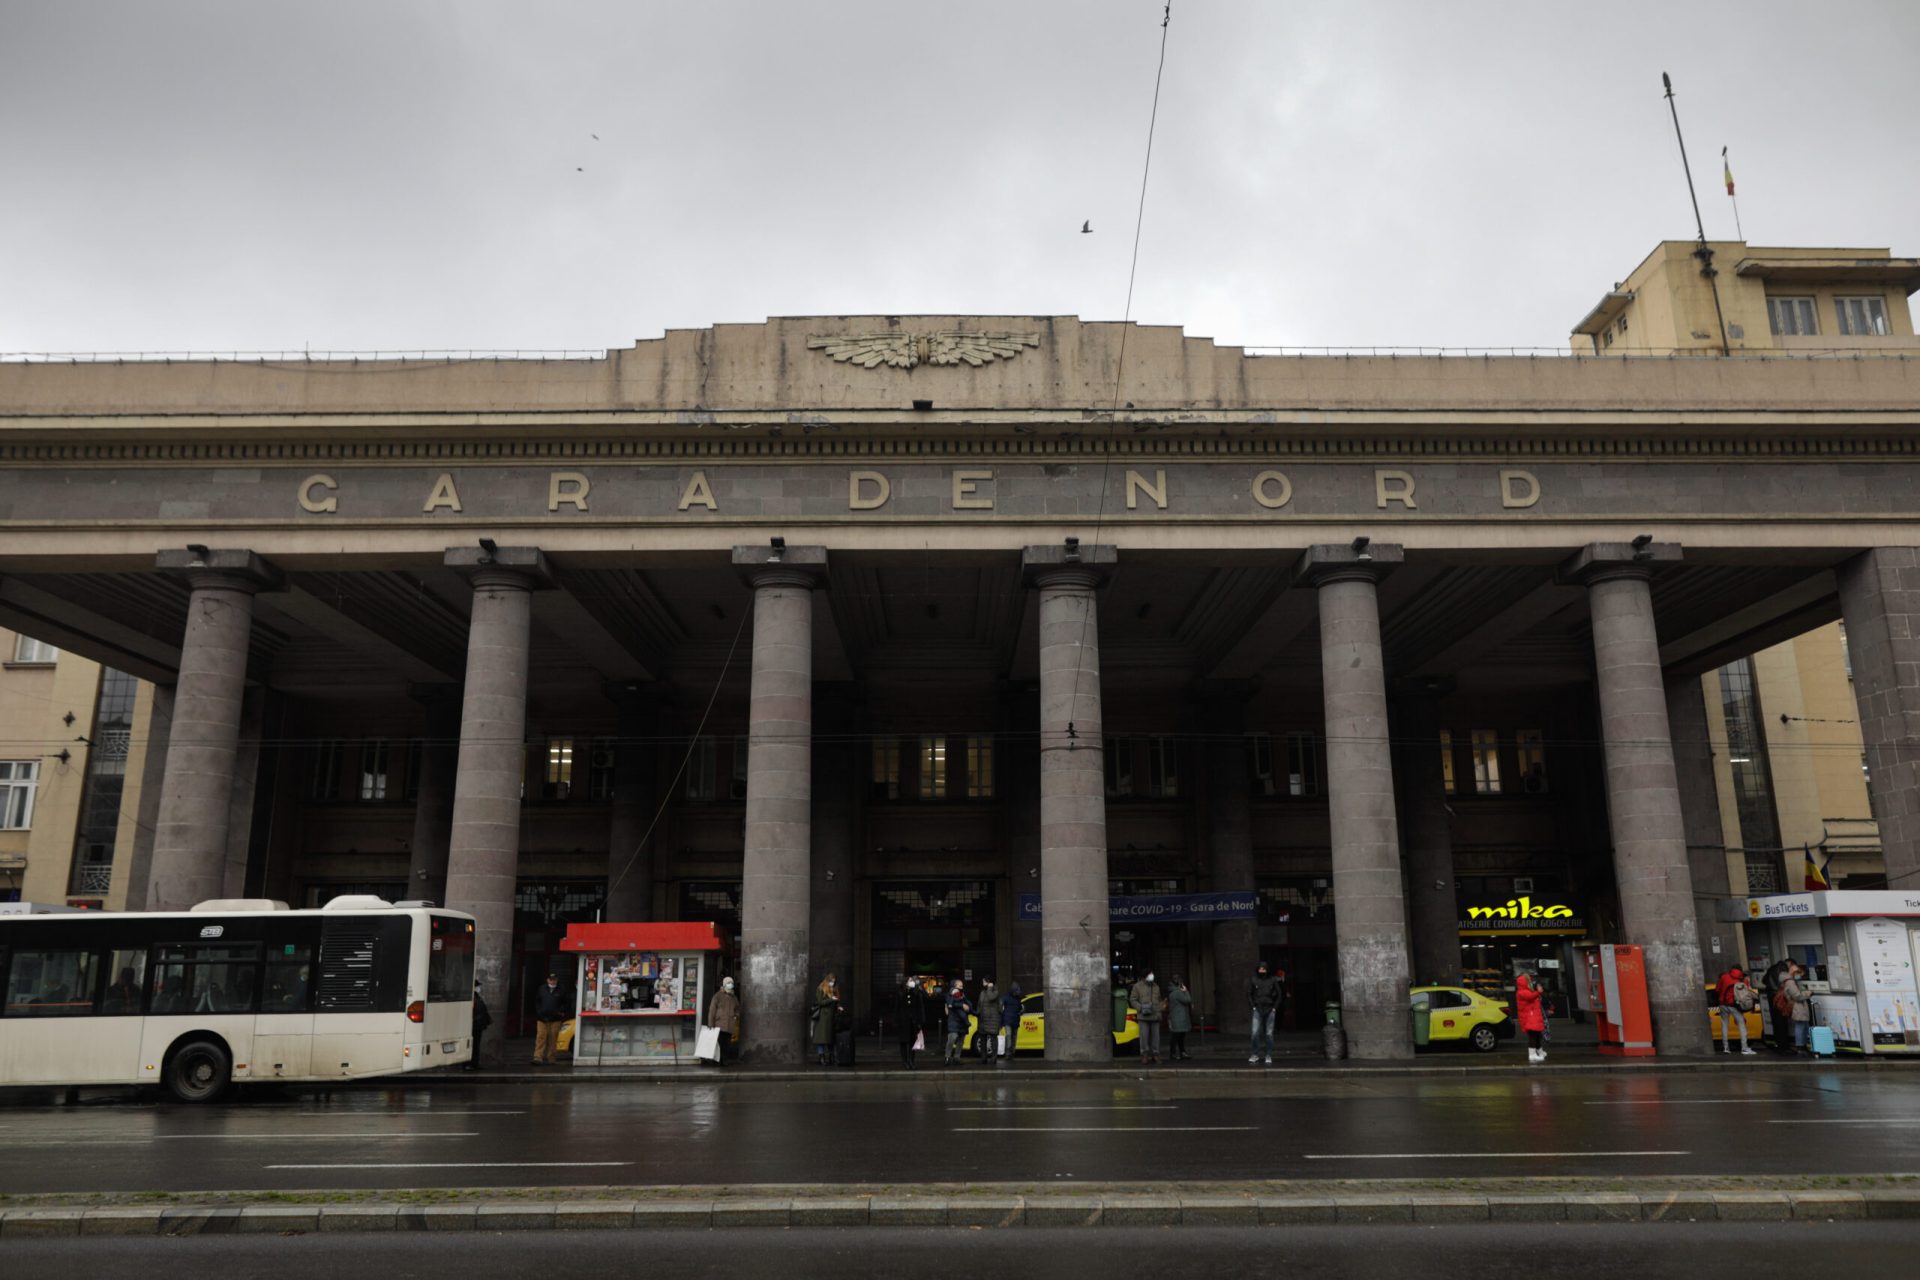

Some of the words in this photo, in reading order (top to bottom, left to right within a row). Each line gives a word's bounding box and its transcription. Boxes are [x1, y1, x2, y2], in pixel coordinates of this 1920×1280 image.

[298, 471, 718, 514] GARA
[849, 470, 994, 510] DE
[1125, 470, 1541, 510] NORD
[1130, 905, 1164, 916] COVID
[1190, 903, 1215, 912] Gara
[1216, 901, 1230, 911] de
[1232, 900, 1255, 911] Nord
[1466, 895, 1574, 919] mika
[1458, 919, 1491, 929] ATISERIE
